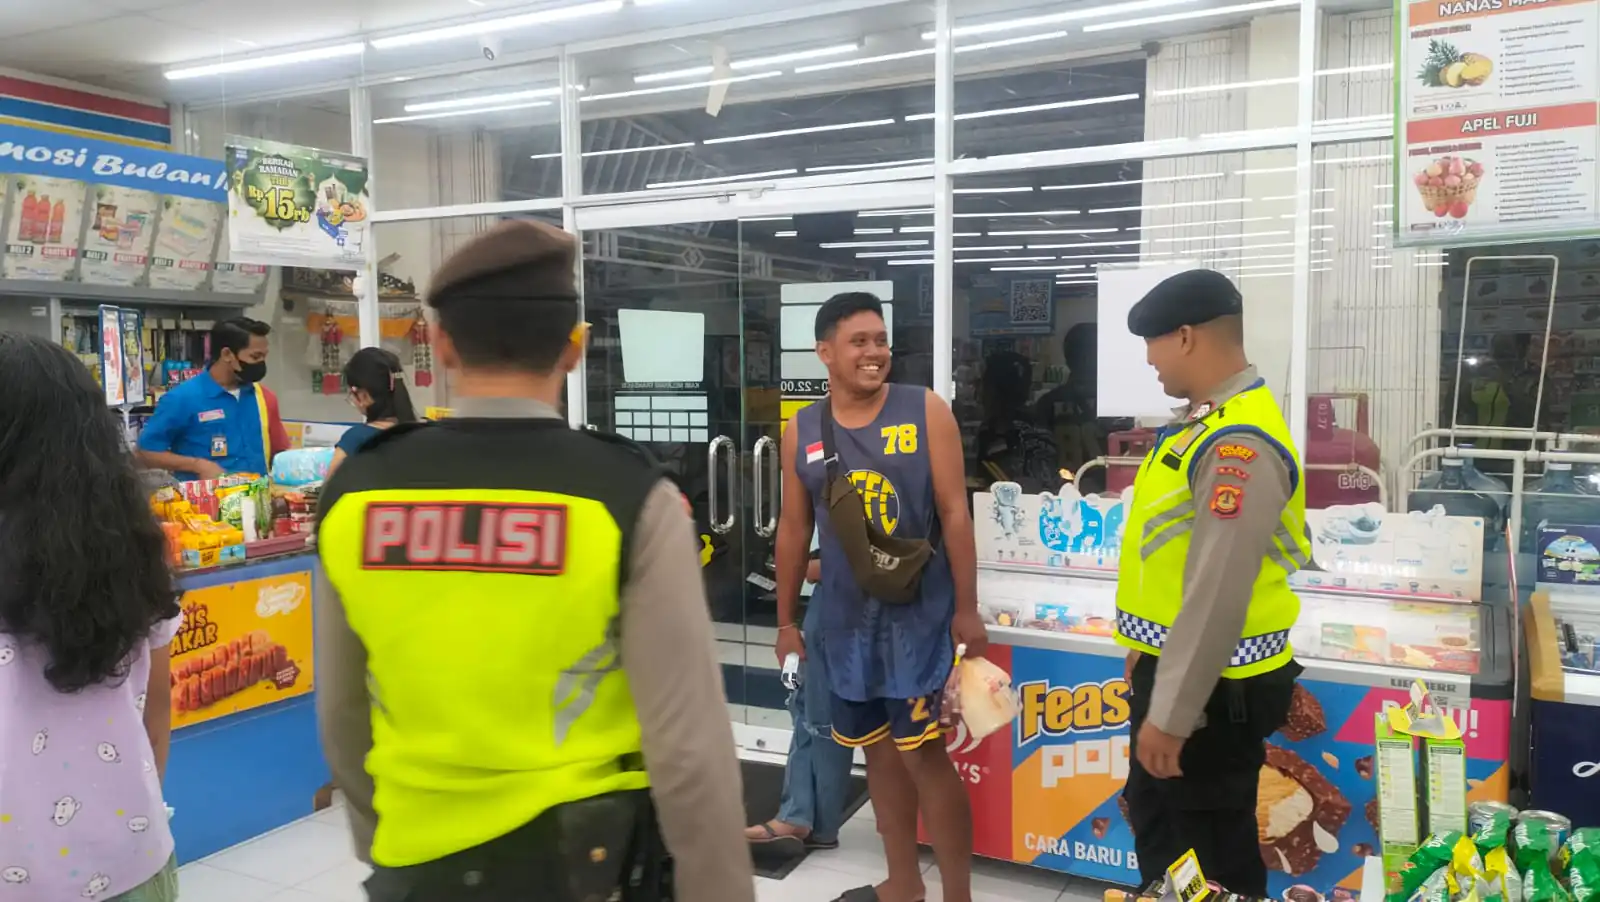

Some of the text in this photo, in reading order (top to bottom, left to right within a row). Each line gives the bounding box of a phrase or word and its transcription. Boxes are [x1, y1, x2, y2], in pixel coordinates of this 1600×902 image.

[1461, 113, 1537, 133] APEL FUJI
[93, 154, 211, 187] Bulan
[259, 165, 299, 178] RAMADAN
[881, 423, 918, 455] 78
[366, 506, 562, 567] POLISI
[1024, 832, 1070, 858] CARA
[1074, 841, 1121, 867] BARU
